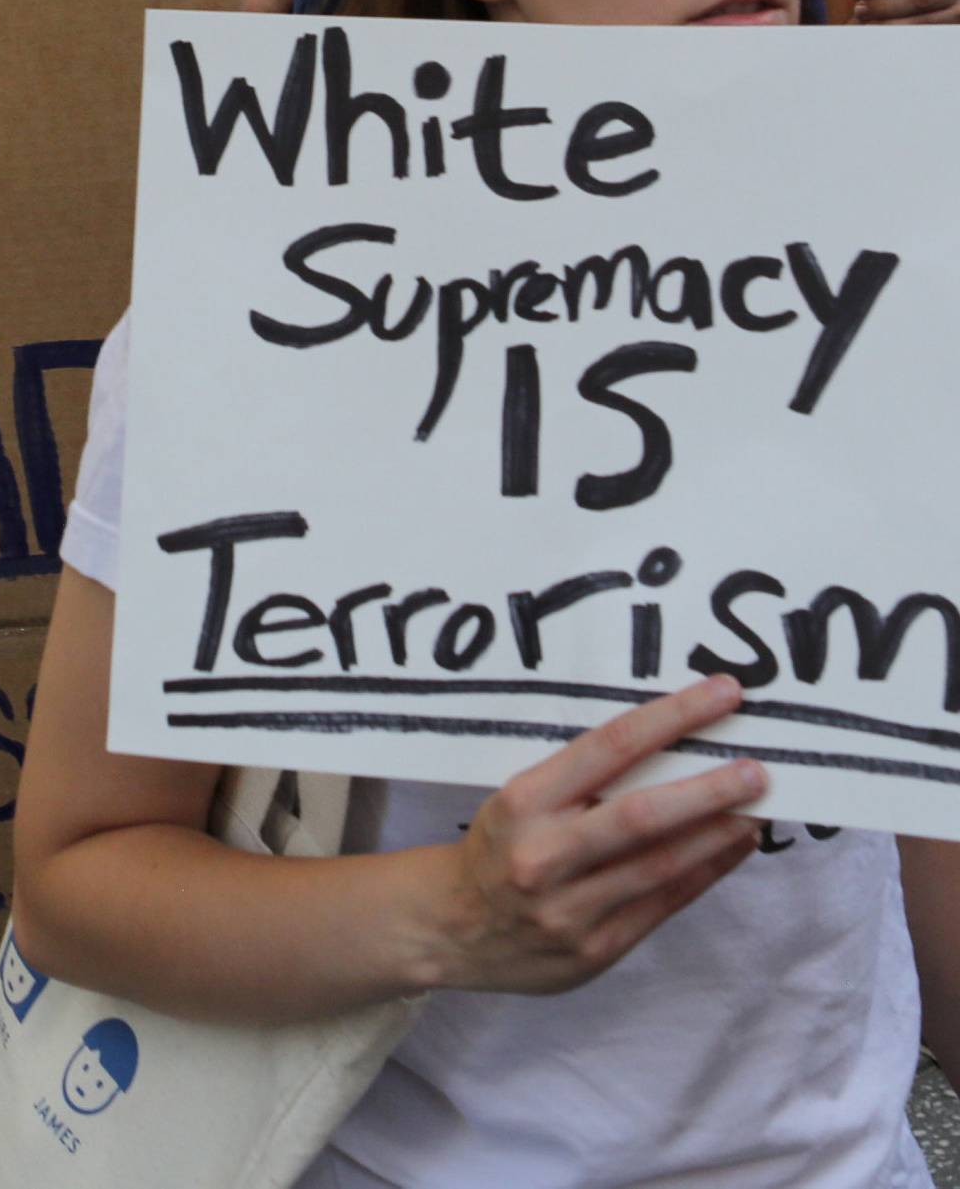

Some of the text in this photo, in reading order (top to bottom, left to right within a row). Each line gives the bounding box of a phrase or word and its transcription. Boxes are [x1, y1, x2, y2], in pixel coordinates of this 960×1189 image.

[170, 26, 660, 202] White
[249, 222, 900, 443] Supremacy
[500, 340, 699, 511] IS
[156, 510, 960, 713] Terrorism
[33, 1096, 82, 1155] JAMES
